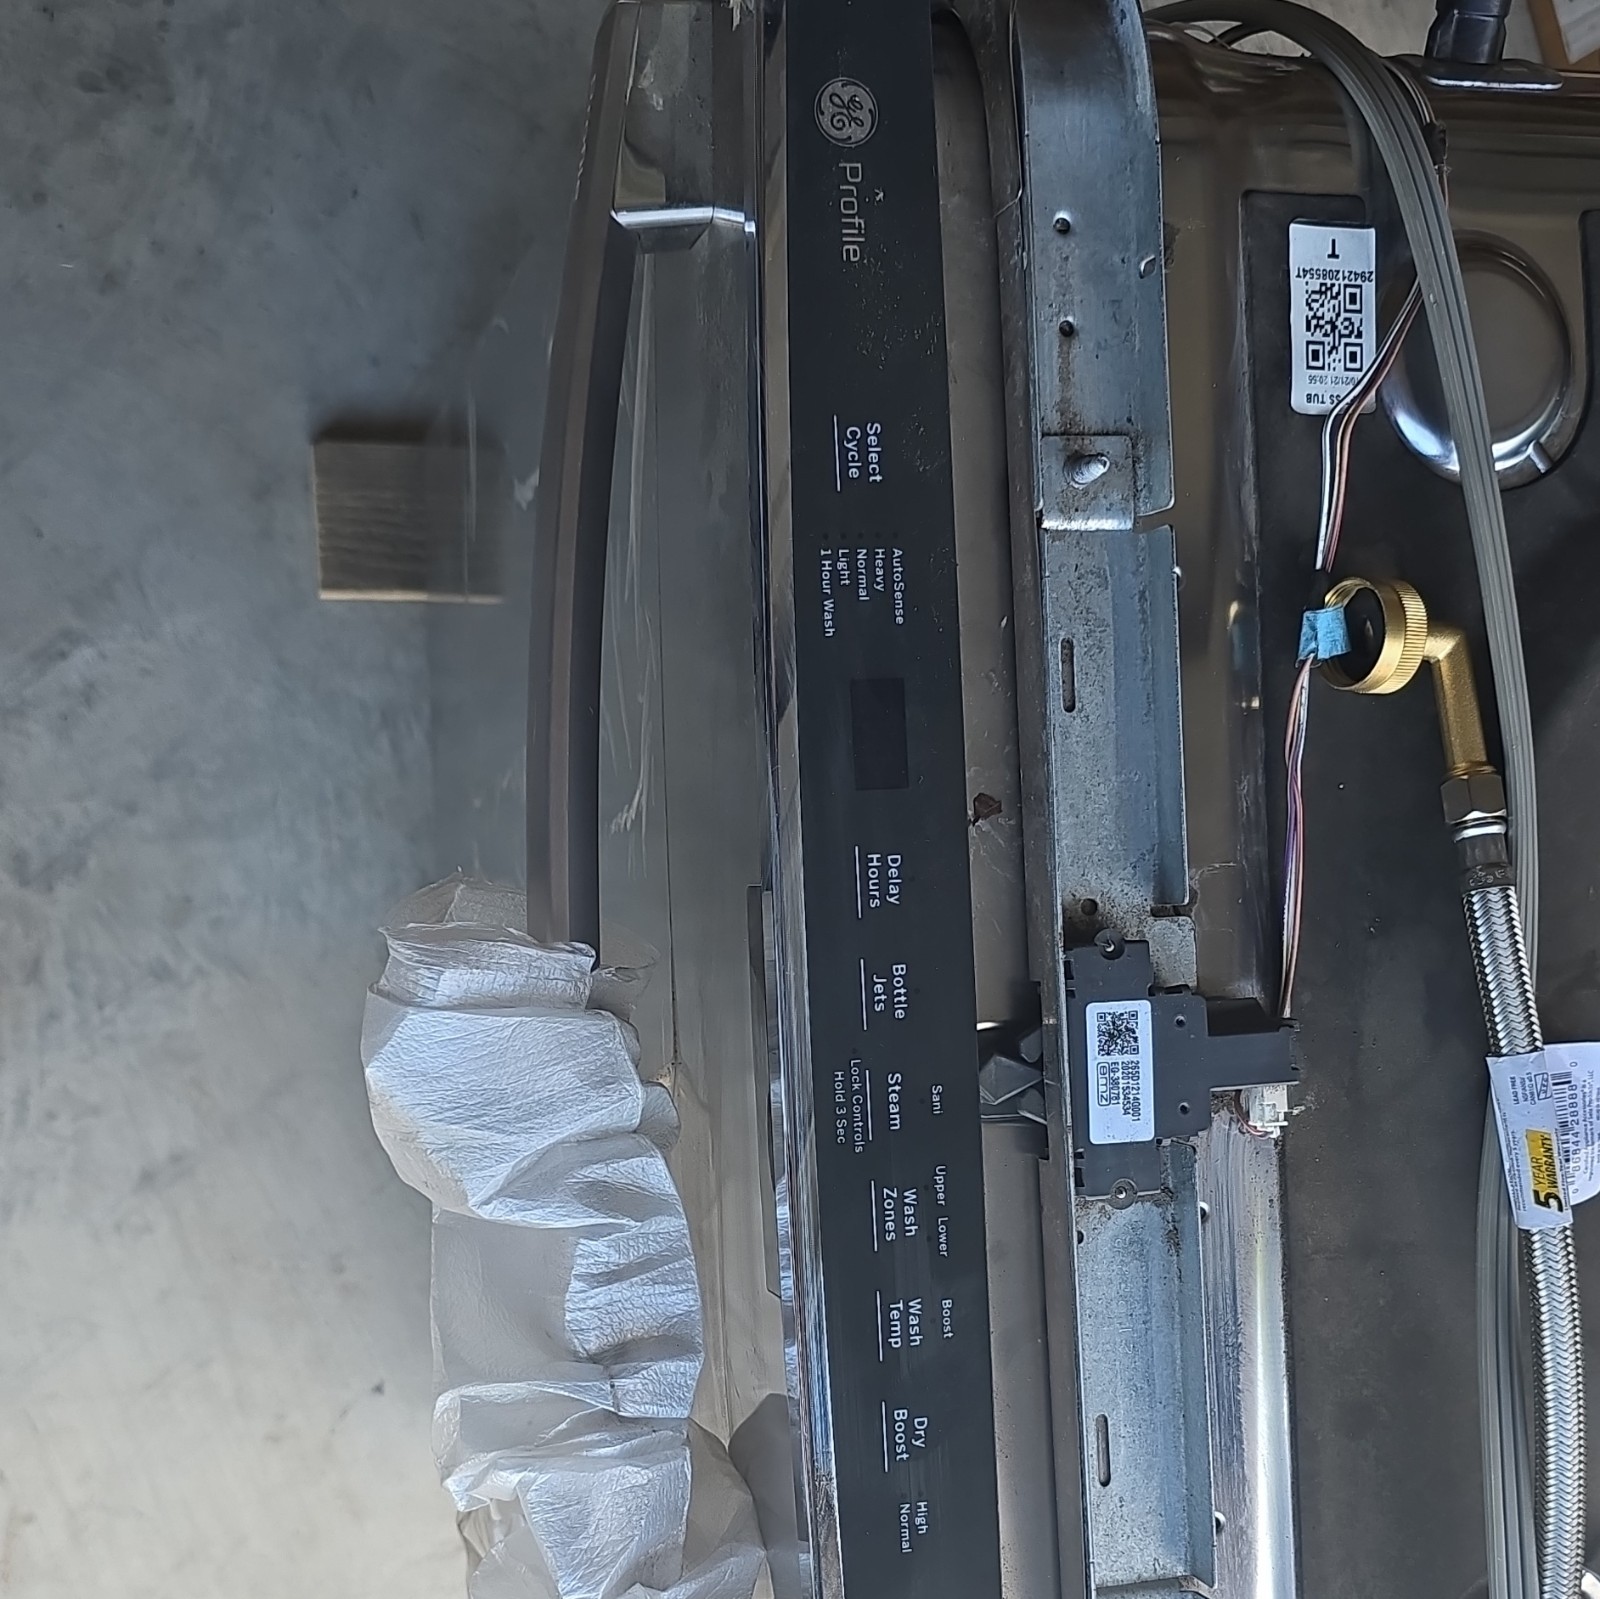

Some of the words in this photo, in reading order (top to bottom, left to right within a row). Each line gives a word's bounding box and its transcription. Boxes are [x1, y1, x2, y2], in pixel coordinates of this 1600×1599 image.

[839, 163, 864, 263] Profile
[1327, 239, 1339, 259] T
[1295, 266, 1373, 282] 29421208554T
[1306, 393, 1326, 404] TUB
[845, 427, 861, 478] Cycle
[867, 423, 882, 482] Select
[822, 561, 832, 594] Hour
[837, 550, 850, 585] Light
[857, 549, 869, 600] Normal
[874, 549, 885, 591] Heavy
[893, 549, 904, 624] AutoSense
[824, 599, 835, 636] Wash
[868, 854, 881, 907] Hours
[886, 855, 902, 904] Delay
[874, 975, 887, 1011] Jets
[893, 965, 907, 1018] Bottle
[835, 1072, 845, 1101] Hold
[851, 1060, 862, 1090] Lock
[1099, 1065, 1108, 1103] emz
[888, 1073, 901, 1129] Steam
[932, 1086, 943, 1113] Sani
[1567, 1084, 1579, 1126] 28888
[837, 1120, 847, 1143] Sec
[853, 1095, 865, 1152] Controls
[1531, 1156, 1546, 1186] YEAR
[1540, 1135, 1558, 1189] WARRANTY
[1570, 1131, 1581, 1172] 86844
[934, 1166, 946, 1205] Upper
[1532, 1189, 1564, 1212] 5
[884, 1188, 897, 1241] Zones
[904, 1189, 918, 1236] Wash
[938, 1218, 948, 1256] Lower
[888, 1300, 903, 1347] Temp
[909, 1299, 923, 1345] Wash
[942, 1300, 953, 1338] Boost
[894, 1409, 909, 1460] Boost
[912, 1418, 927, 1447] Dry
[900, 1504, 912, 1552] Normal
[915, 1502, 928, 1533] High
